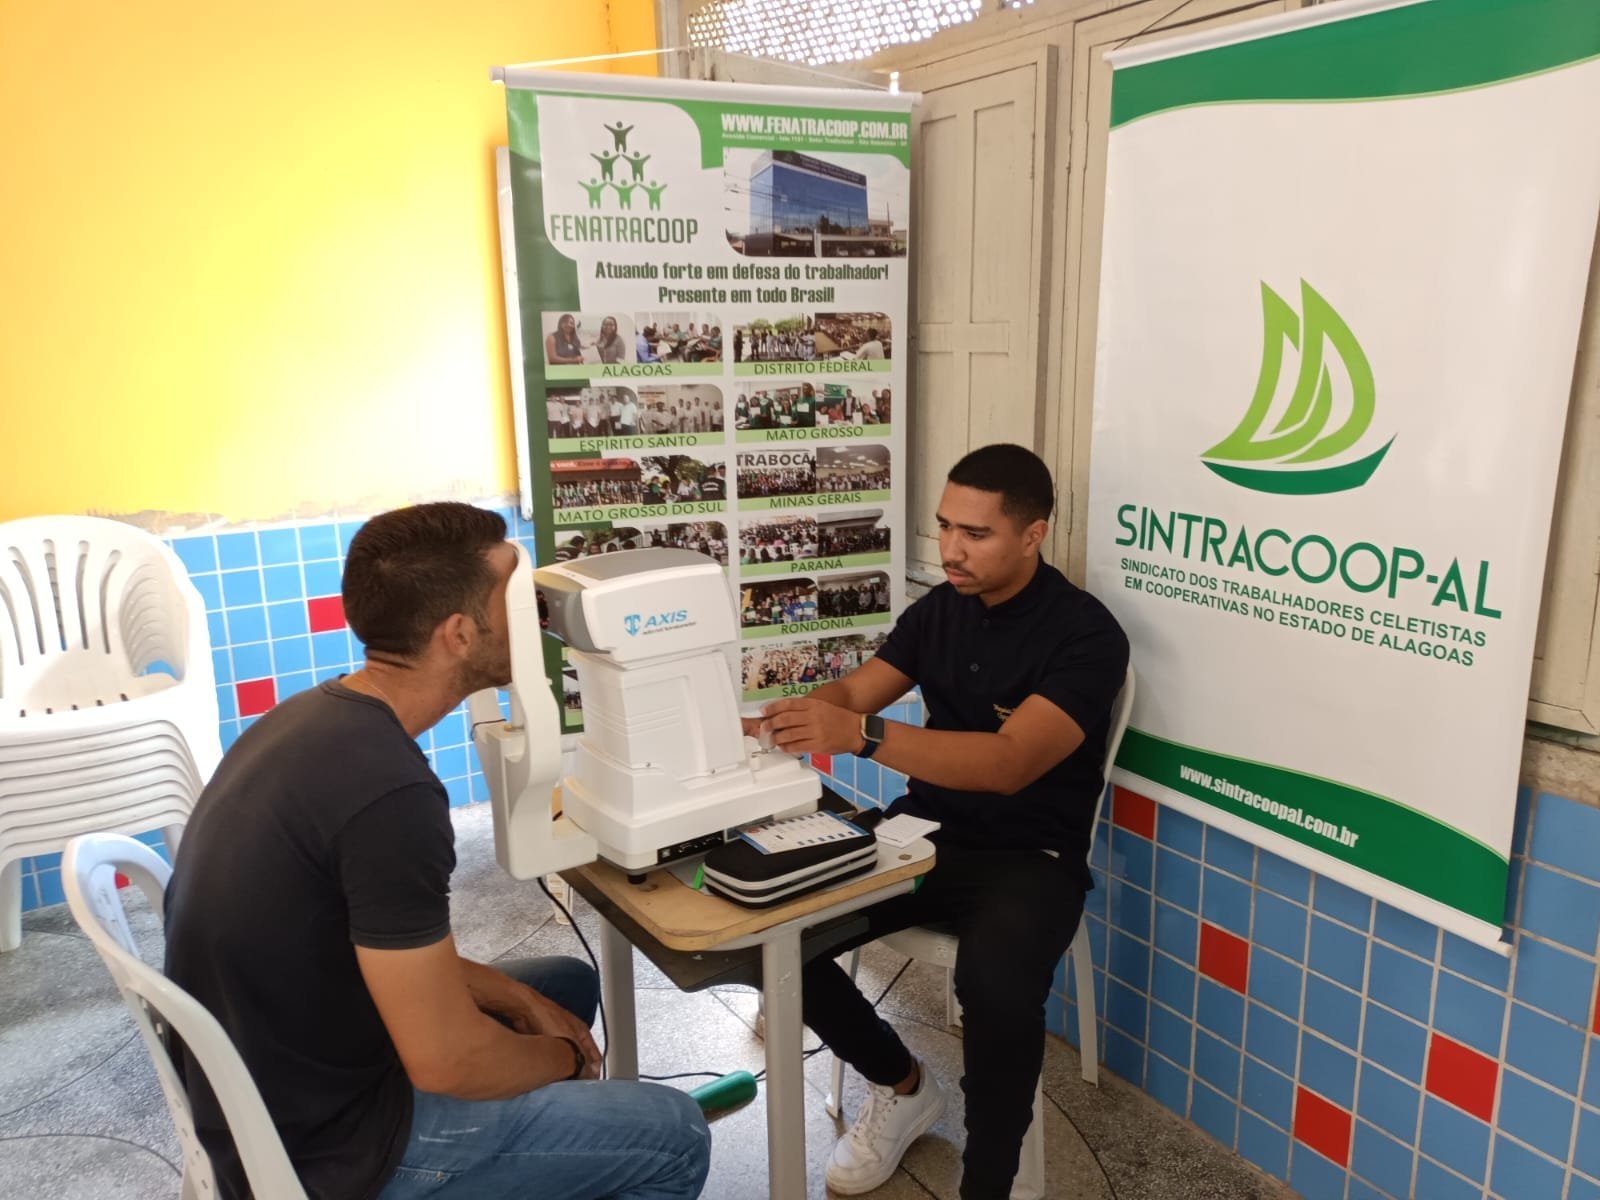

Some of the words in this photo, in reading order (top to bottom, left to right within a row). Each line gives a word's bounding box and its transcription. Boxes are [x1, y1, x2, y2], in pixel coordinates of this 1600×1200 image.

[721, 113, 907, 139] WWW.FENATRACOOP.COM.BR
[550, 214, 698, 243] FENATRACOOP
[595, 261, 658, 279] Atuando
[662, 262, 702, 279] forte
[706, 265, 728, 279] em
[732, 263, 780, 280] defesa
[784, 263, 800, 280] do
[805, 264, 889, 280] trabalhador!
[658, 286, 726, 303] Presente
[730, 289, 752, 303] em
[756, 287, 787, 303] todo
[790, 287, 835, 303] Brasil!
[602, 364, 672, 377] ALAGOAS
[754, 362, 815, 375] DISTRITO
[819, 359, 873, 373] FEDERAL
[647, 435, 697, 448] SANTO
[766, 428, 806, 441] MATO
[810, 425, 864, 438] GROSSO
[769, 496, 814, 509] MINAS
[817, 492, 862, 505] GERAIS
[558, 509, 606, 523] MATO
[608, 505, 668, 519] GROSSO
[672, 503, 694, 516] DO
[699, 501, 723, 514] SUL
[1115, 503, 1502, 619] SINTRACOOP-AL
[1120, 557, 1186, 583] SINDICATO
[1189, 572, 1218, 591] DOS
[1222, 579, 1365, 622] TRABALHADORES
[1369, 610, 1487, 647] CELETISTAS
[644, 609, 688, 628] AXIS
[1124, 576, 1143, 591] EM
[1145, 580, 1249, 616] COOPERATIVAS
[1252, 605, 1275, 622] NO
[1279, 611, 1347, 639] ESTADO
[1351, 626, 1375, 645] DE
[1379, 633, 1474, 667] ALAGOAS
[782, 684, 808, 697] SÃO
[1180, 764, 1360, 849] www.sintracoopal.com.br
